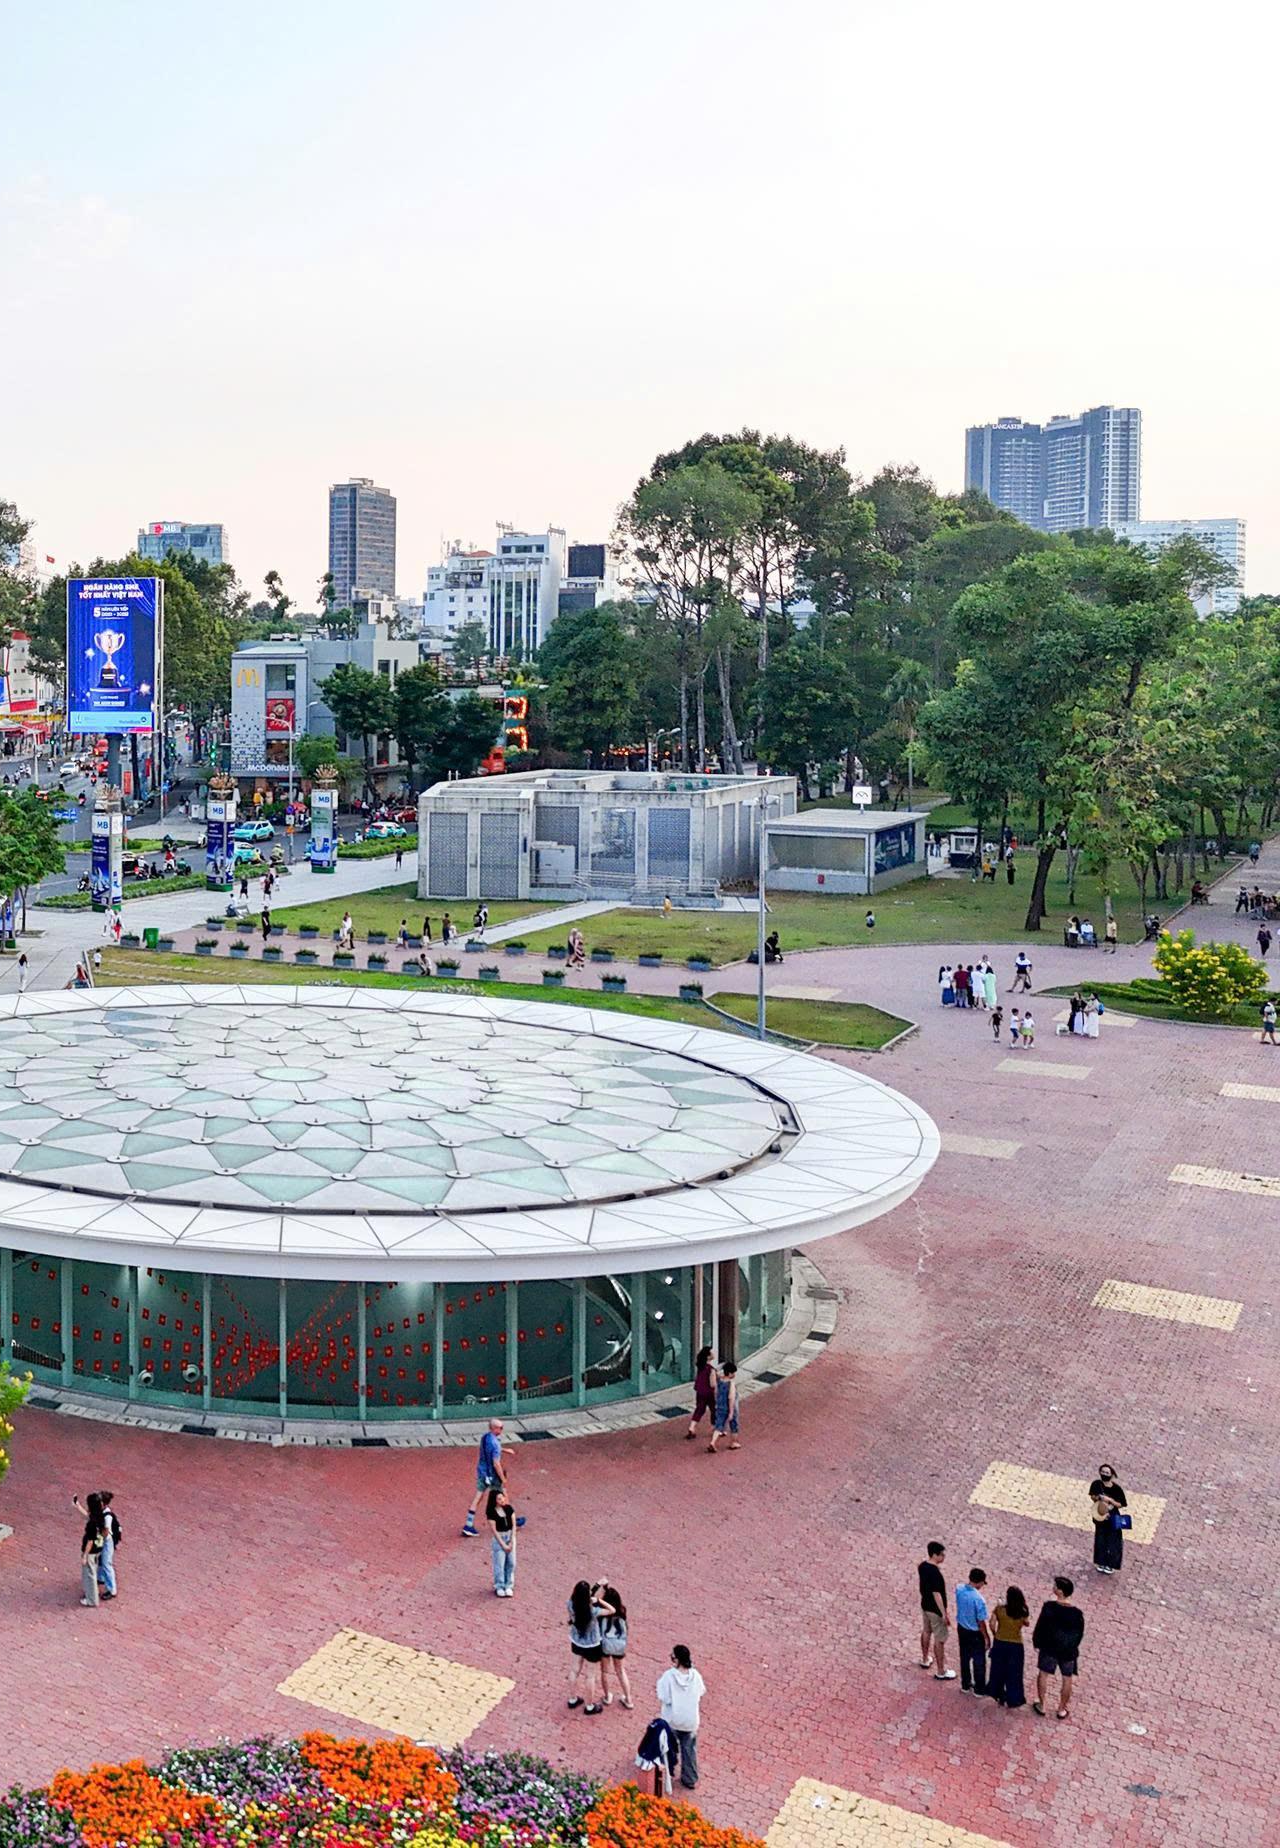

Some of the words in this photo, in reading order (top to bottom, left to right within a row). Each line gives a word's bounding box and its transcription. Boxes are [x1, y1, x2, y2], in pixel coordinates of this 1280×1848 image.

[79, 590, 92, 599] TỐT
[112, 591, 127, 600] VIỆT
[93, 606, 100, 618] 5
[247, 764, 295, 772] McDonalds
[97, 821, 109, 829] MB
